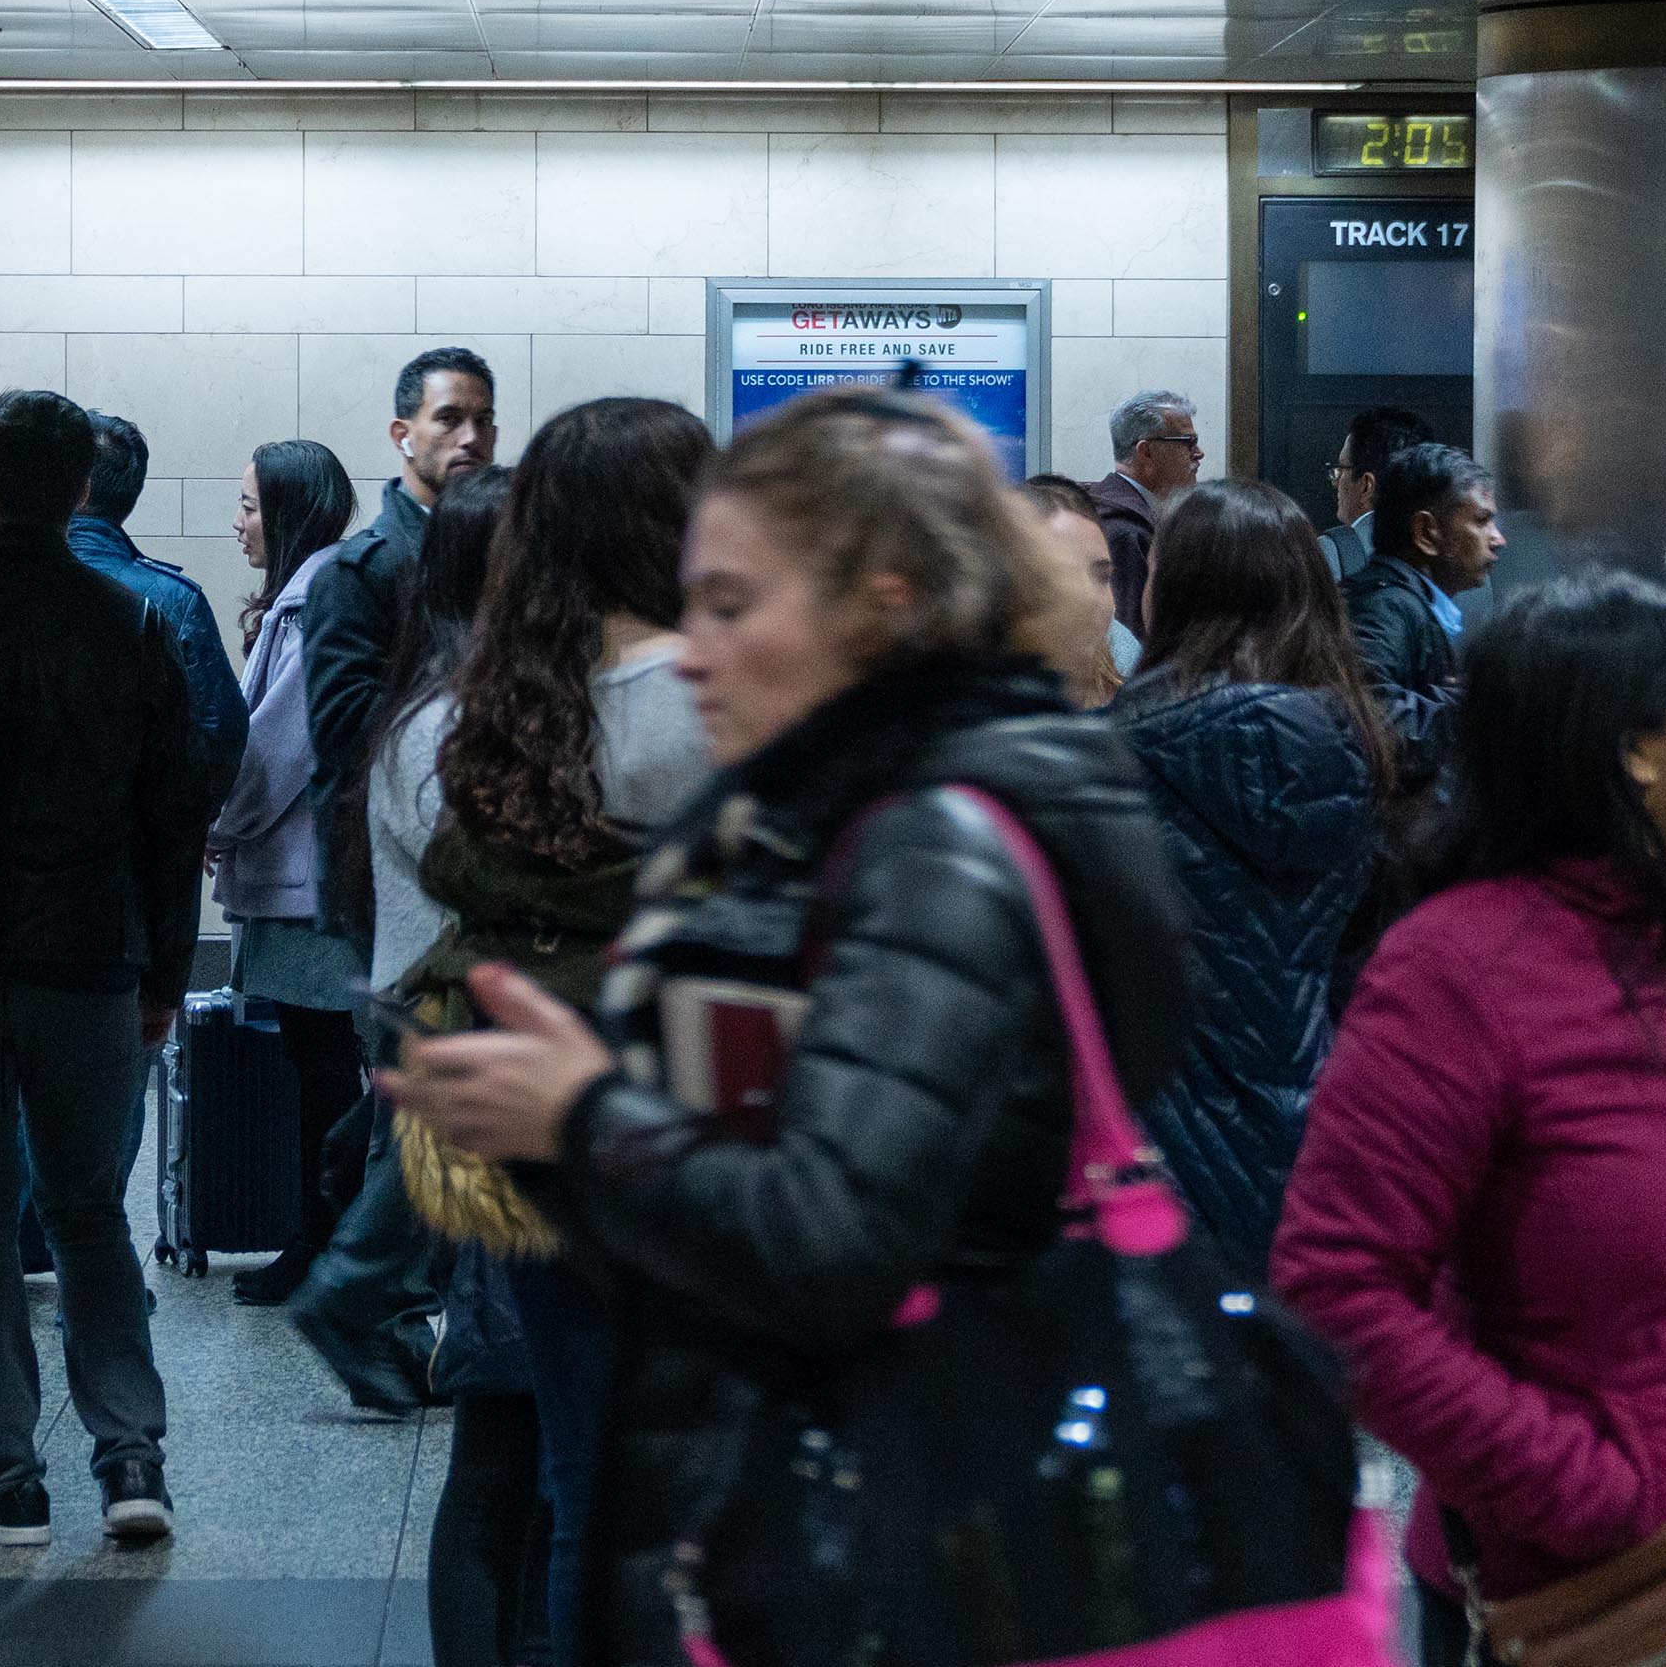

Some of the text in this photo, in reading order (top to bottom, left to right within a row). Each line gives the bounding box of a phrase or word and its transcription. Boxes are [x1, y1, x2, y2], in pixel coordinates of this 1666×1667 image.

[1330, 221, 1469, 246] TRACK 17
[792, 310, 931, 330] GETAWAYS
[800, 343, 956, 355] RIDE FREE AND SAVE
[741, 375, 764, 386] USE
[767, 375, 804, 386] CODE
[806, 375, 835, 386] LIRR
[923, 375, 941, 386] TO
[942, 375, 966, 386] THE
